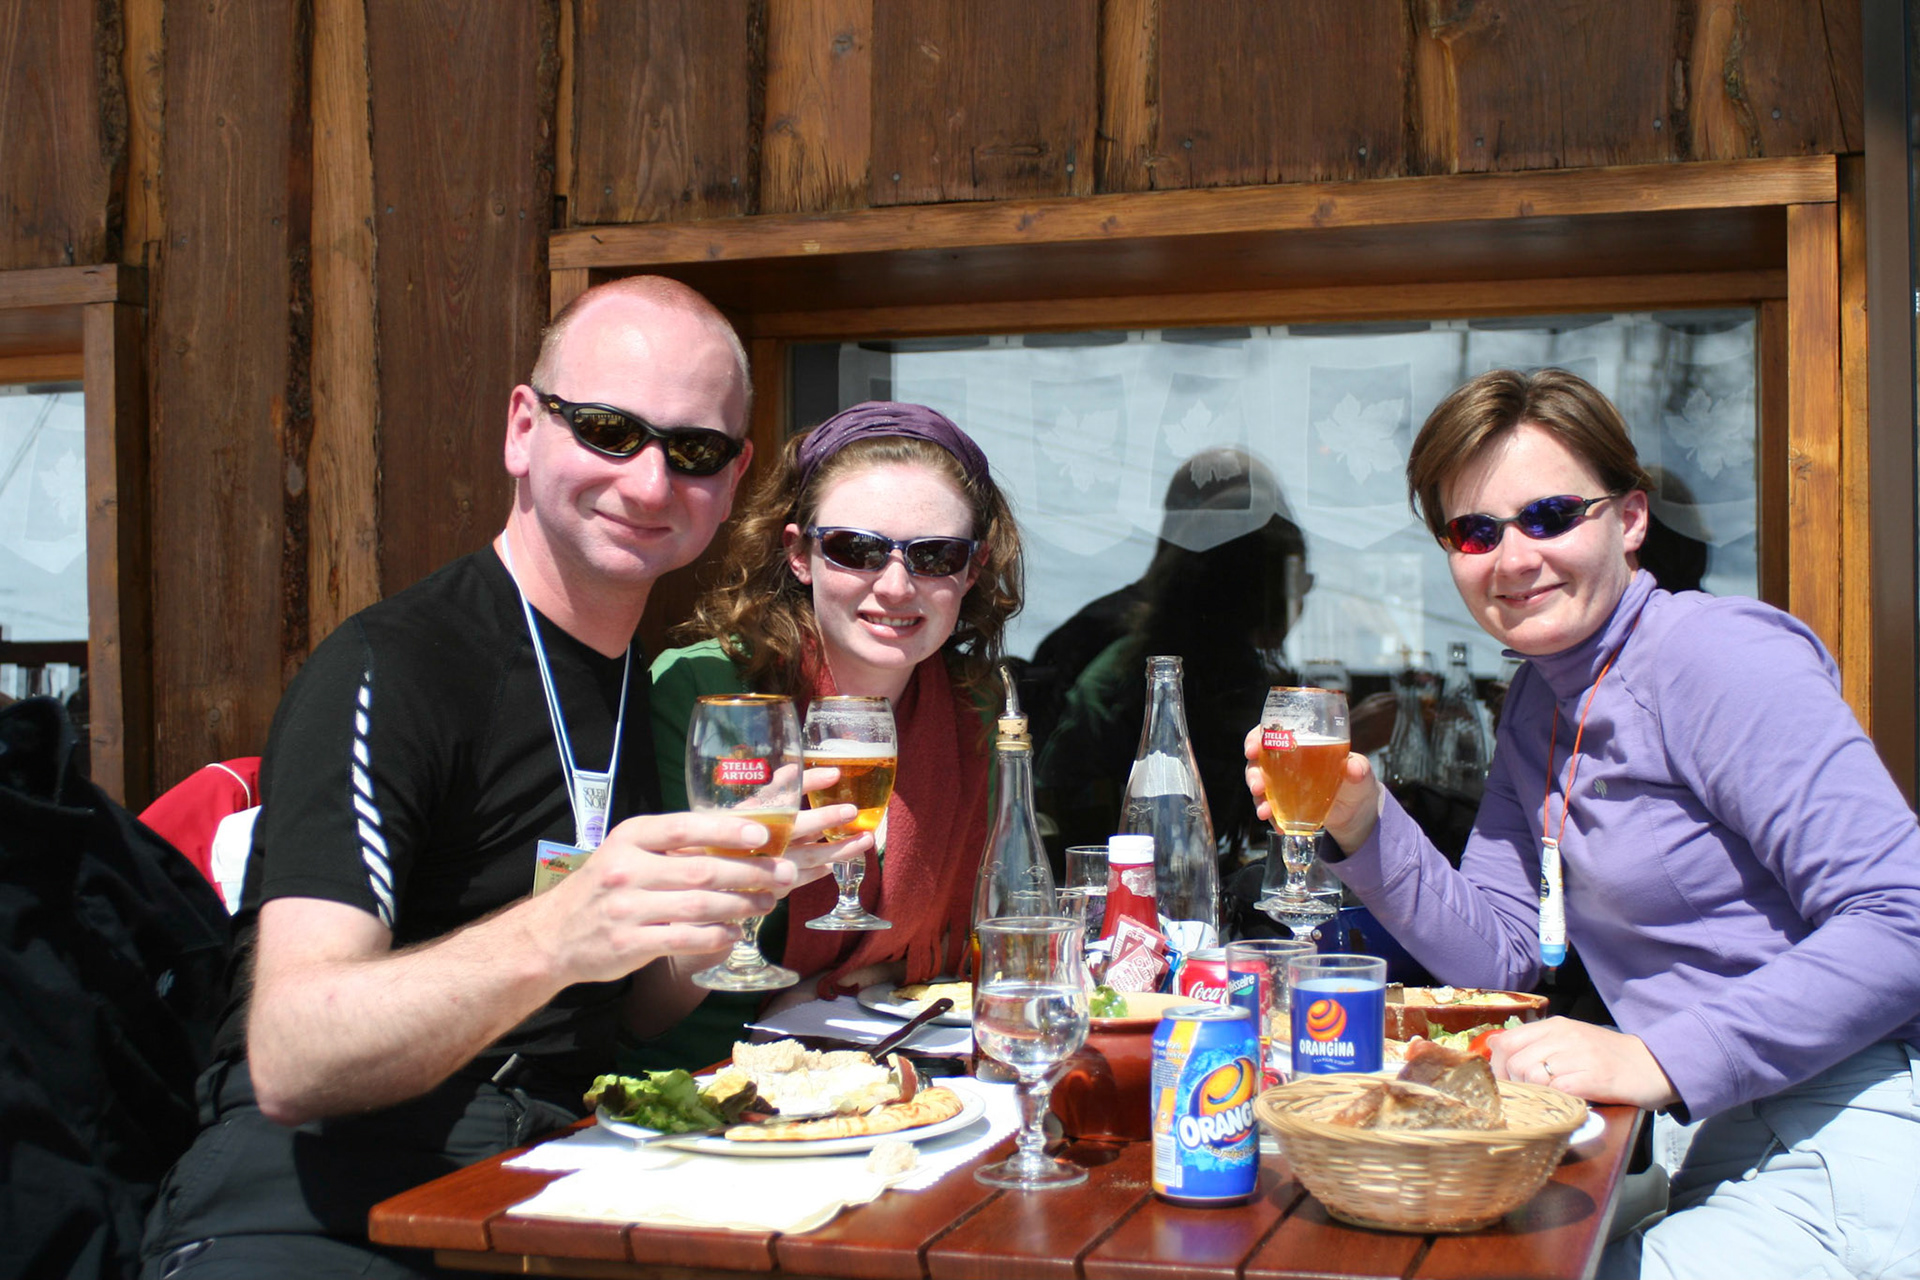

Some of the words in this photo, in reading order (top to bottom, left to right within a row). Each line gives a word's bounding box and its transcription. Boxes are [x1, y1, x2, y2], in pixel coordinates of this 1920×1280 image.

[1264, 732, 1289, 740] STELLA
[1263, 740, 1290, 748] ARTOIS
[721, 761, 765, 771] STELLA
[721, 771, 765, 781] ARTOIS
[1179, 1101, 1254, 1149] ORANG
